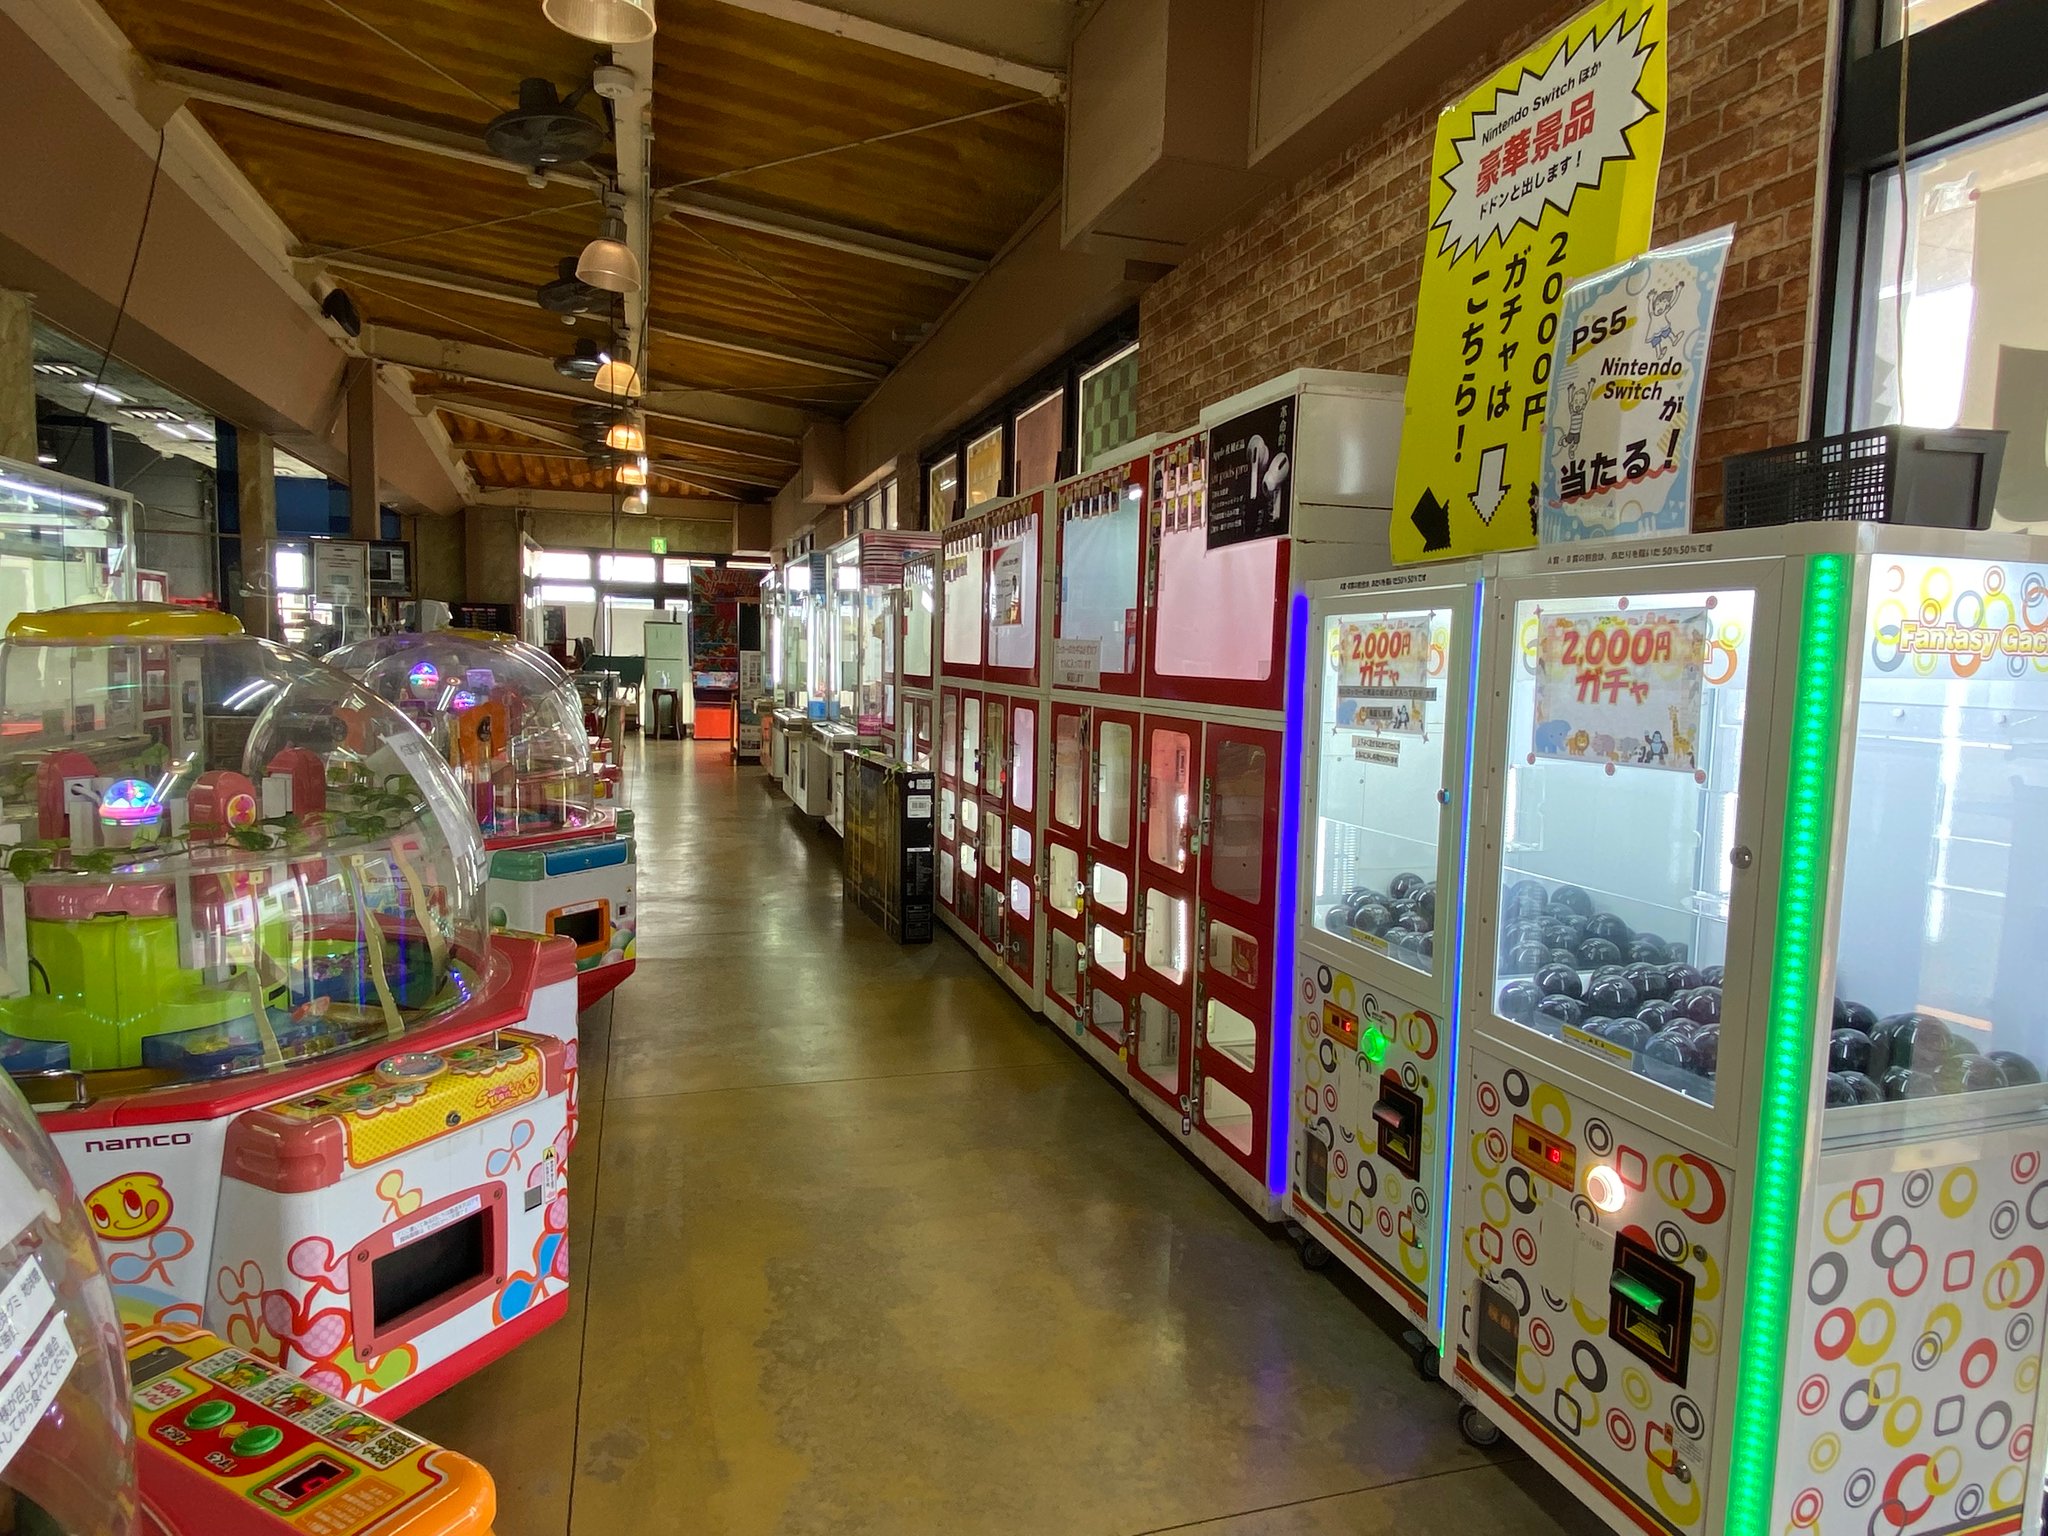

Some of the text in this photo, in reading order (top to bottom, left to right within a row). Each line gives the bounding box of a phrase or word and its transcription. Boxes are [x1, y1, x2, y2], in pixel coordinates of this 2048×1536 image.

[1481, 59, 1602, 146] Nintendo Switch ほか
[1475, 90, 1596, 198] 豪華景品
[1486, 245, 1532, 422] ガチャは
[1571, 306, 1629, 355] PS5
[1600, 356, 1683, 378] Nintendo
[1603, 381, 1683, 423] Switch が
[1560, 428, 1680, 502] 当たる！
[1352, 630, 1411, 660] 2,000円
[1561, 627, 1672, 666] 2,000円
[1900, 619, 2000, 660] Fantasy
[1359, 660, 1400, 687] ガチャ
[1574, 666, 1650, 706] ガチャ
[85, 1132, 191, 1153] namco
